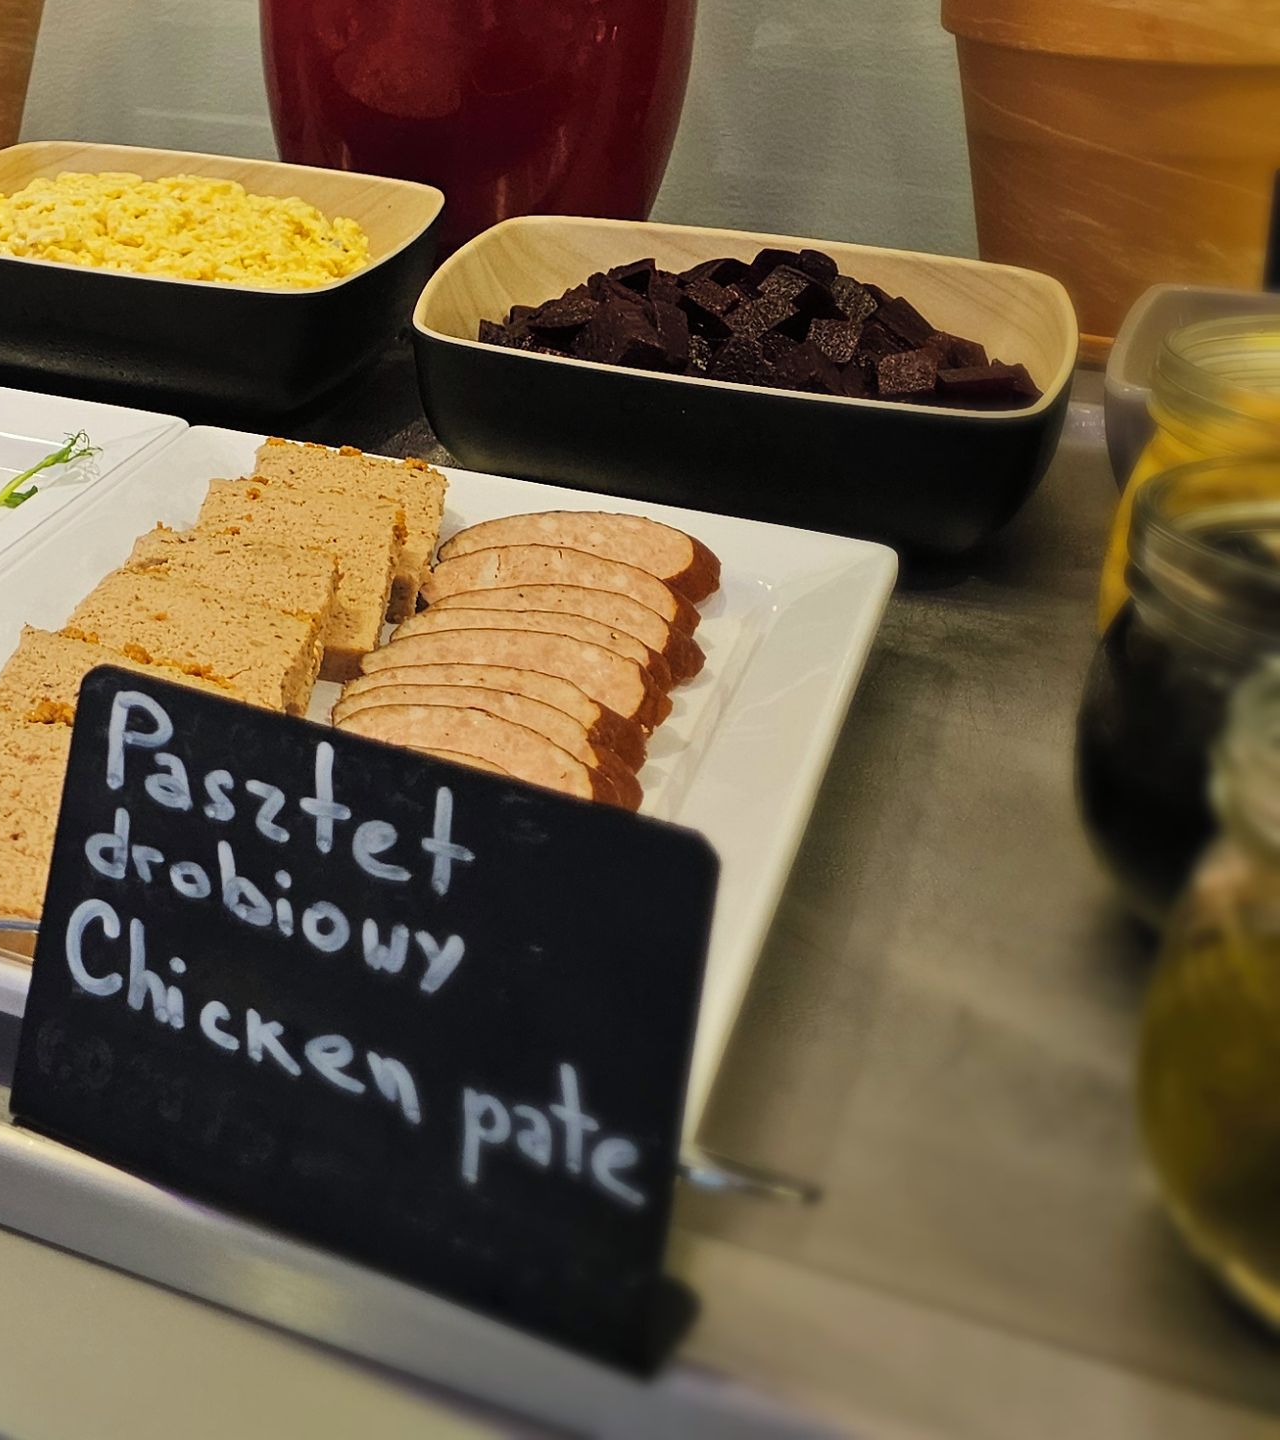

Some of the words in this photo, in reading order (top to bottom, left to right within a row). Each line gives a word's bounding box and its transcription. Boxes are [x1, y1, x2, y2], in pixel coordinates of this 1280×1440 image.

[106, 691, 476, 895] Pasztet
[84, 808, 466, 993] drobiowy
[65, 898, 422, 1125] Chicken
[461, 1062, 646, 1206] pate
